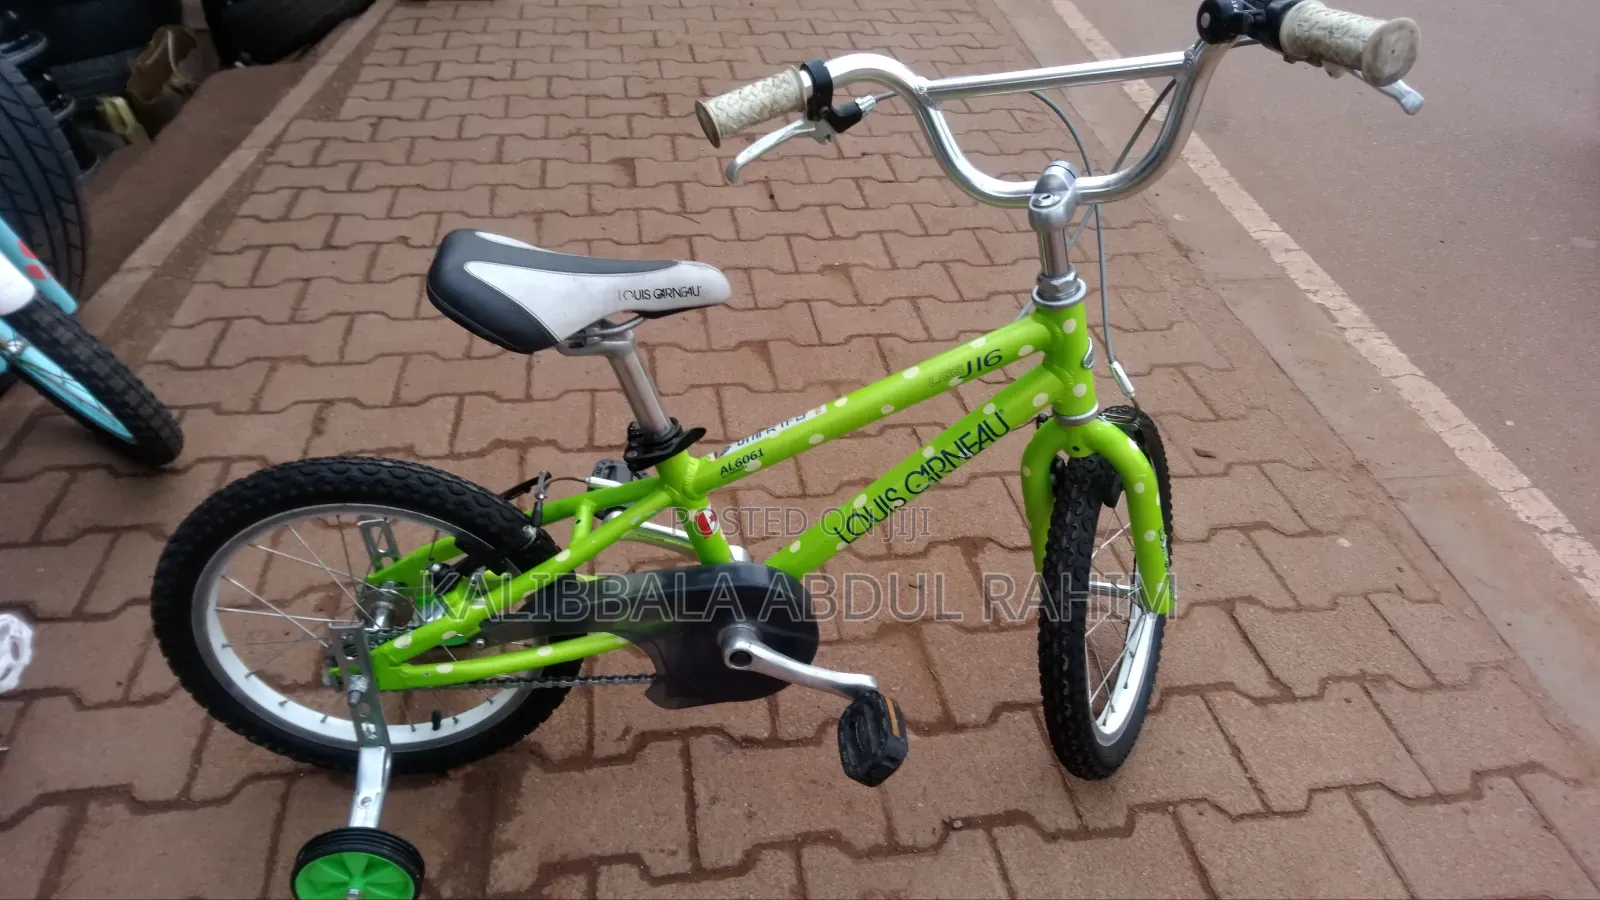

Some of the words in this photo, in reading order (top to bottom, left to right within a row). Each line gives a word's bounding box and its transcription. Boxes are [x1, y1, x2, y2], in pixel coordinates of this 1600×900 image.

[618, 288, 651, 301] LOUIS
[653, 285, 700, 300] GARNEAU
[720, 447, 764, 476] AL6061
[833, 487, 907, 544] LOUIS
[904, 411, 1010, 495] GARNEAU
